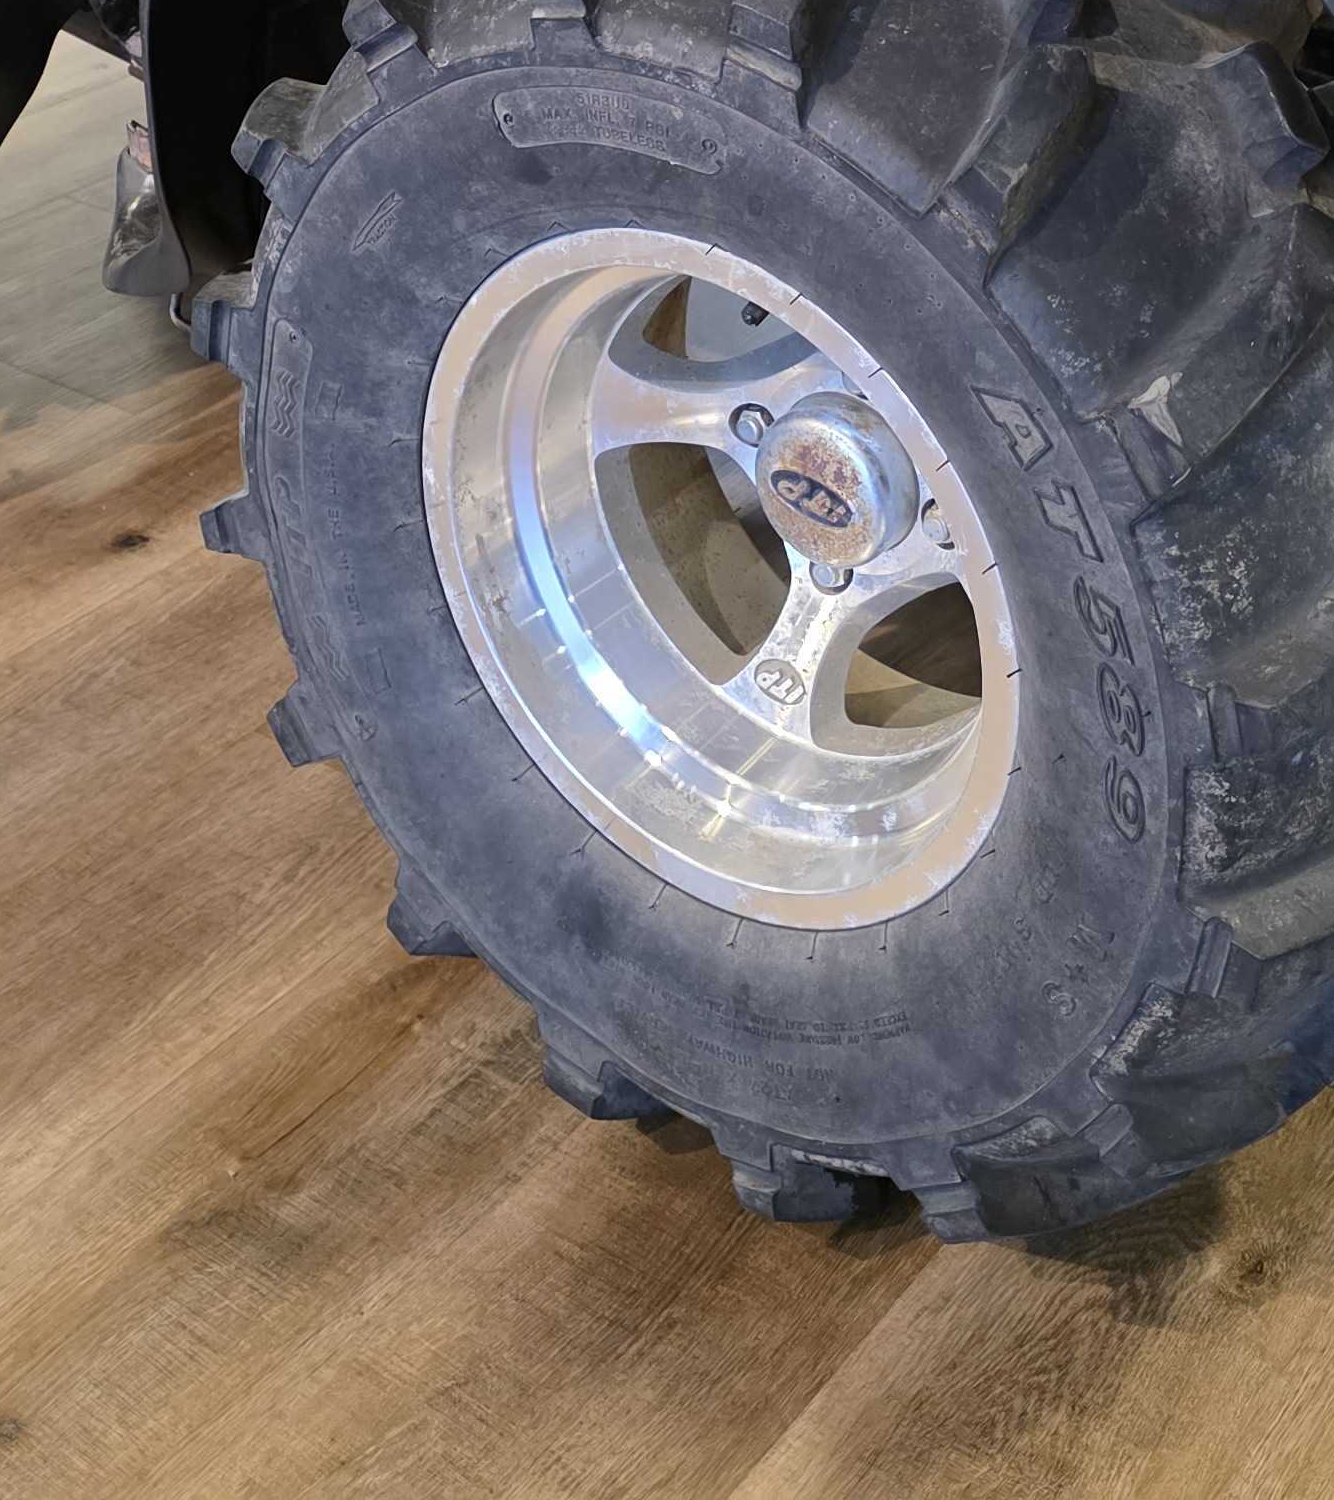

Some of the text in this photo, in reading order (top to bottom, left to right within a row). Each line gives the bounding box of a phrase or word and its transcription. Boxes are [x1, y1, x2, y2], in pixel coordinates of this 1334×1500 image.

[756, 670, 805, 703] ITP
[1073, 575, 1147, 845] 589
[688, 1035, 754, 1069] HIGHWAY
[764, 1060, 796, 1078] FOR
